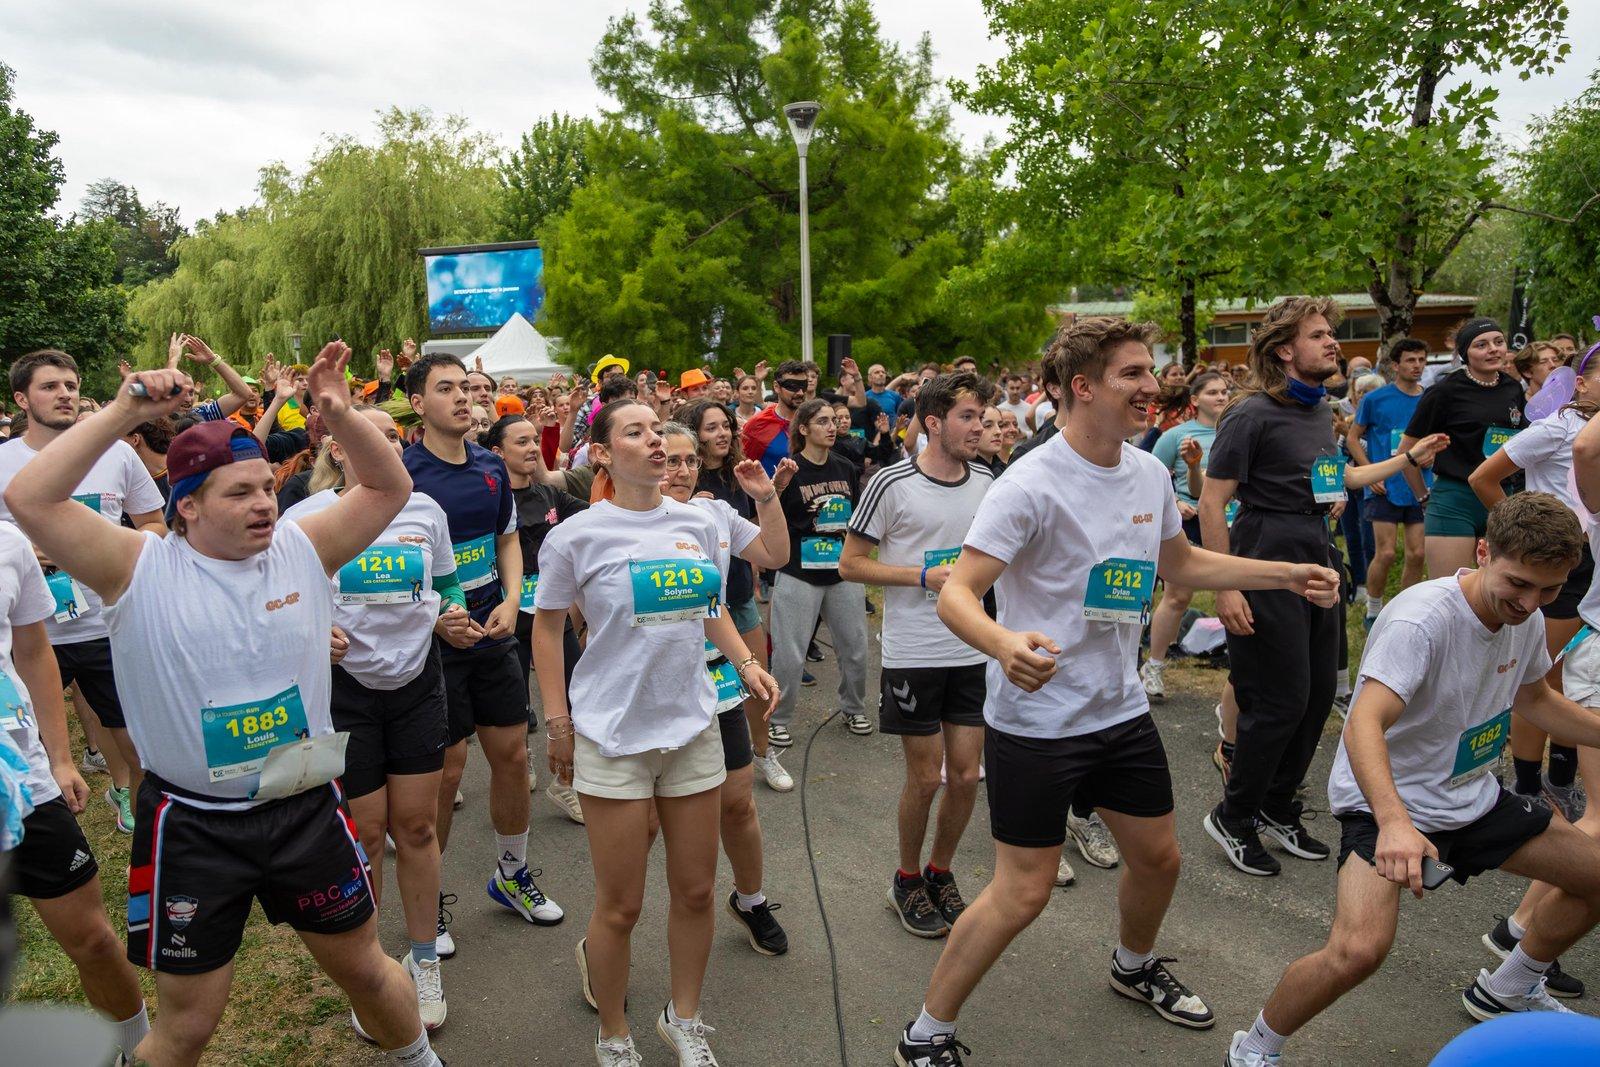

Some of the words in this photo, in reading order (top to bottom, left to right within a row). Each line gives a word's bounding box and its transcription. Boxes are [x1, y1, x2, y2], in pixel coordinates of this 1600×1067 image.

[1491, 433, 1513, 445] 238
[1318, 463, 1337, 477] 1941
[454, 545, 486, 566] 2551
[814, 542, 833, 552] 174
[356, 555, 406, 572] 1211
[650, 567, 704, 588] 1213
[1103, 568, 1142, 588] 1212
[664, 587, 693, 597] Solyne
[1112, 587, 1131, 597] Dylan
[225, 705, 289, 738] 1883
[246, 731, 275, 745] Louis
[1469, 723, 1502, 751] 1882
[298, 884, 341, 911] PBC
